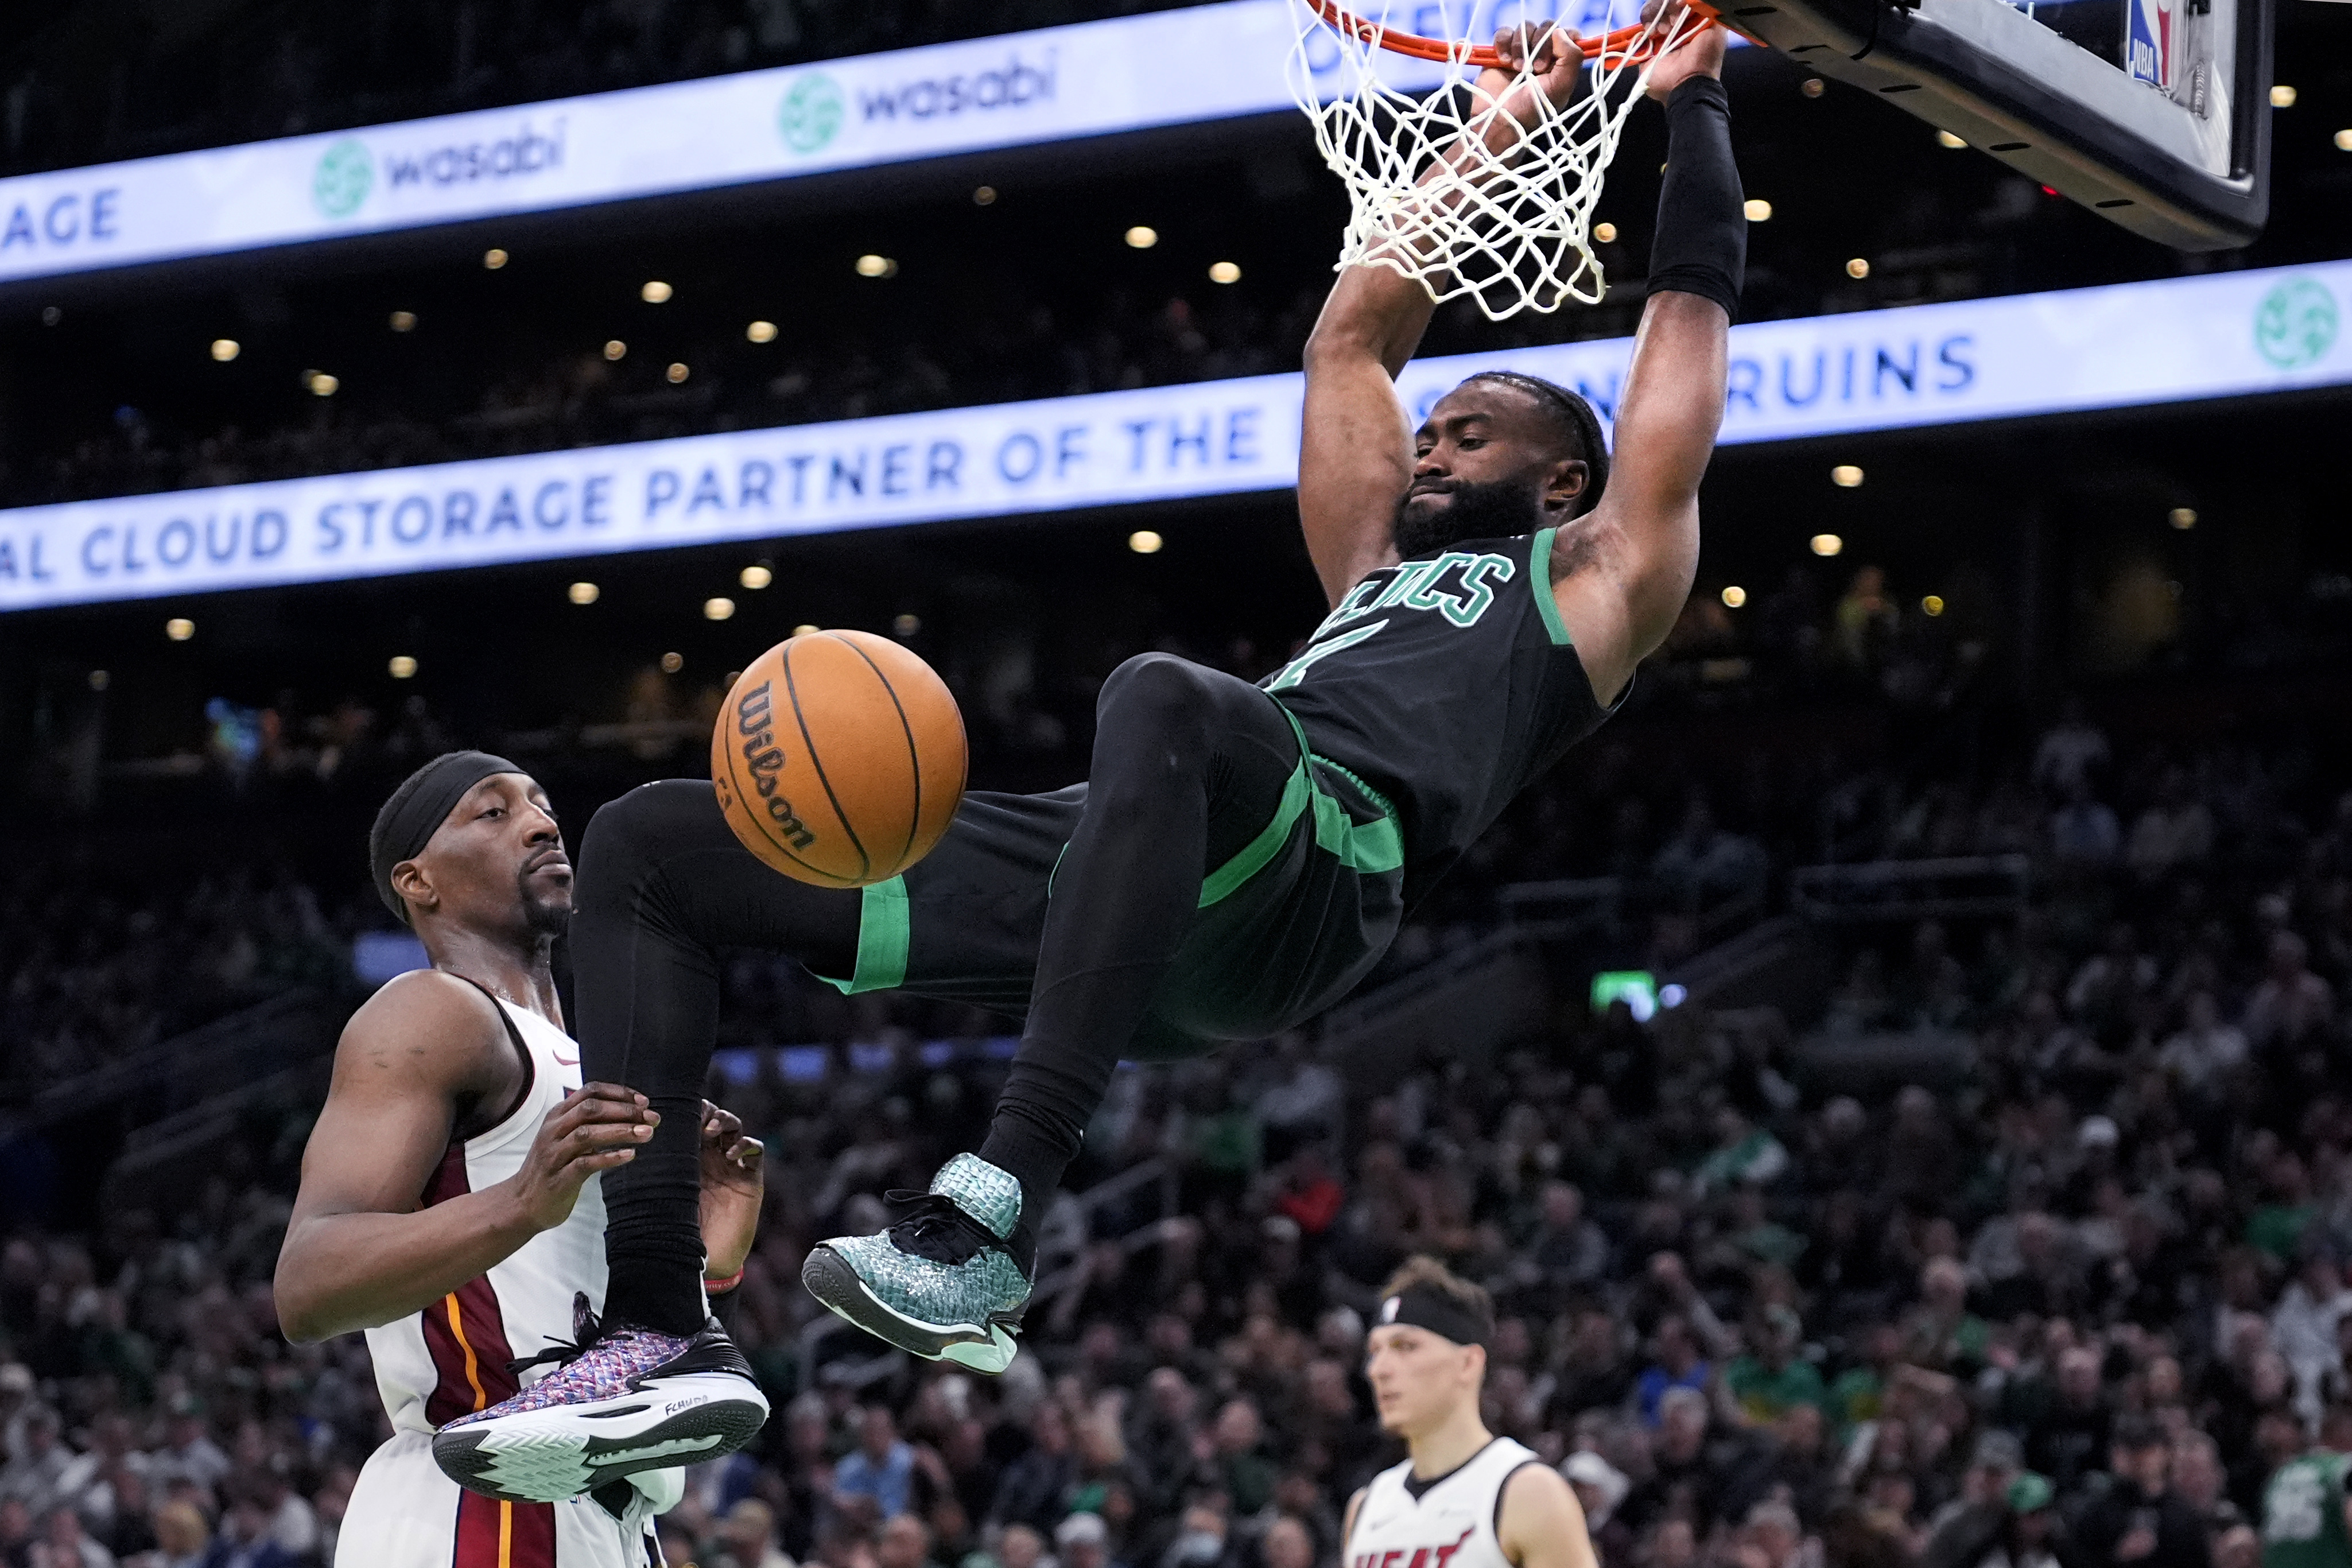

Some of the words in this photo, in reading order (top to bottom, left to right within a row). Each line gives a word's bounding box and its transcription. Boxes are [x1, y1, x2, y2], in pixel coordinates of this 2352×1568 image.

[858, 47, 1058, 119] wasabi
[2133, 38, 2154, 80] NBA
[383, 117, 565, 188] wasabi
[80, 510, 290, 575] CLOUD
[317, 472, 615, 553] STORAGE
[642, 438, 968, 520] PARTNER
[998, 424, 1089, 484] OF
[1119, 406, 1264, 474] THE
[1726, 333, 1978, 410] RUINS
[738, 680, 816, 851] Wilson
